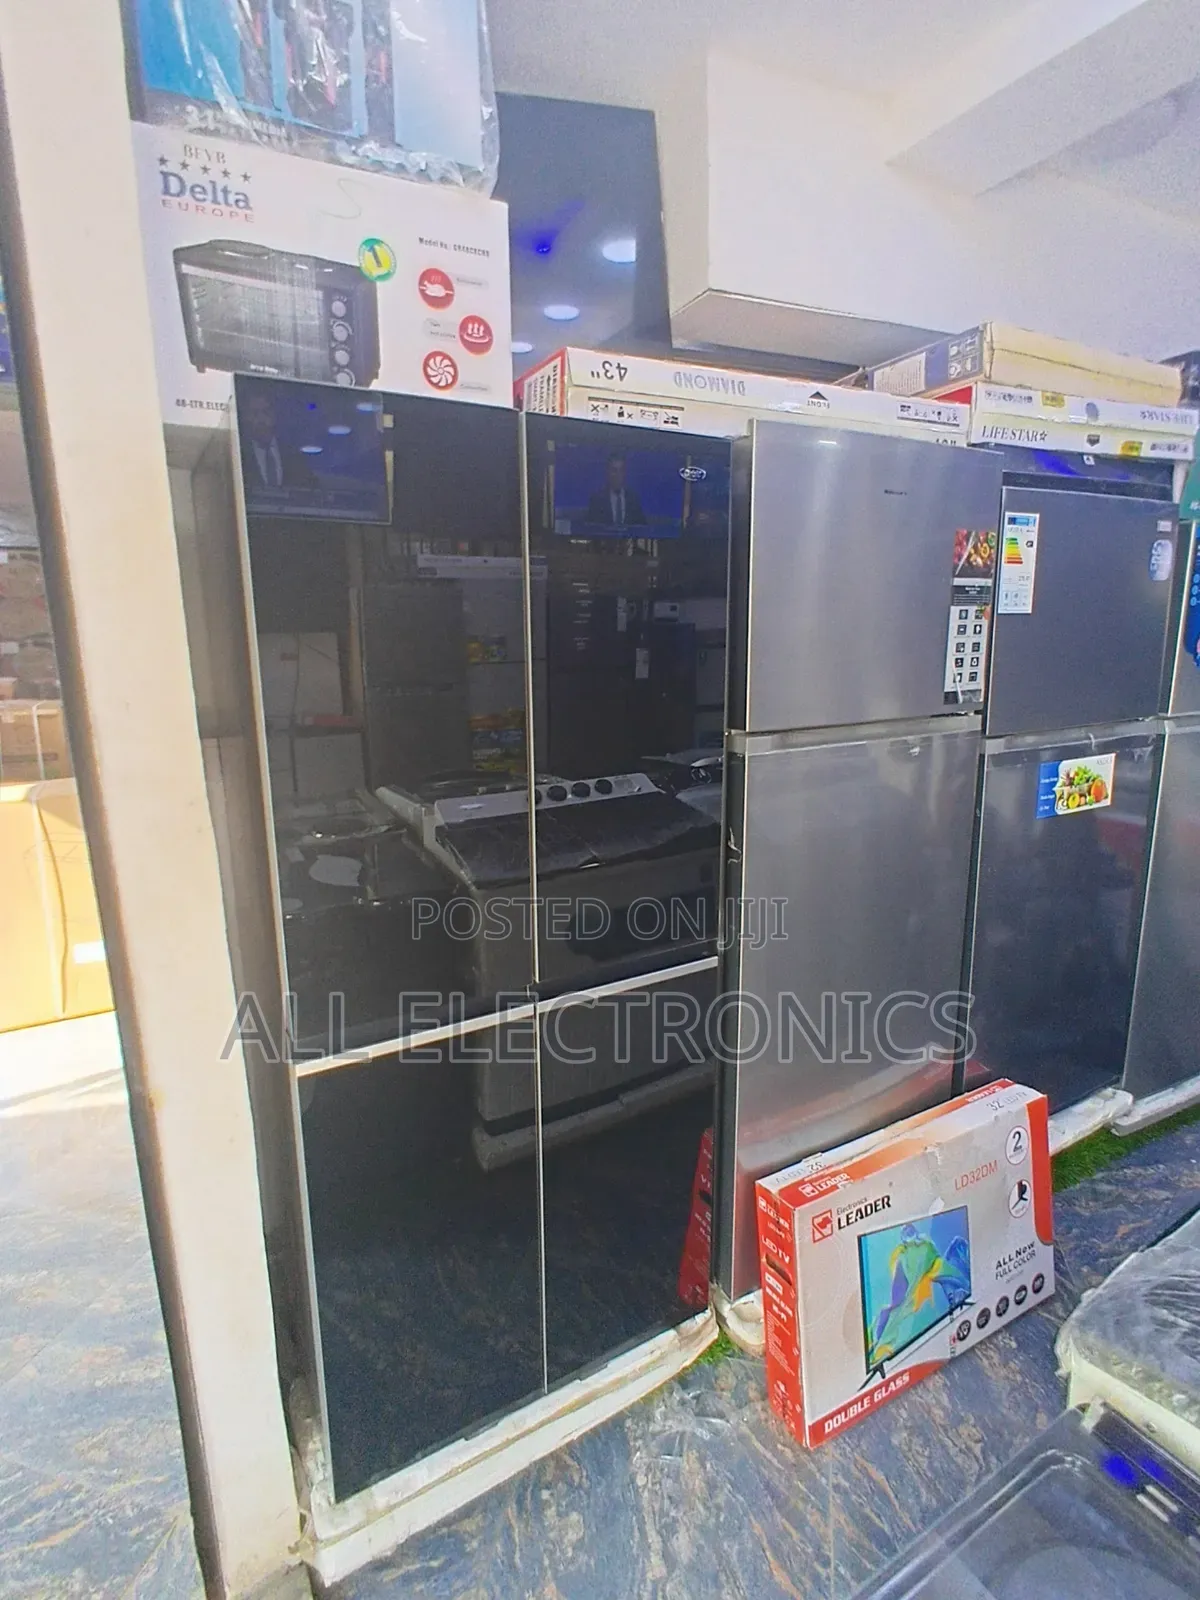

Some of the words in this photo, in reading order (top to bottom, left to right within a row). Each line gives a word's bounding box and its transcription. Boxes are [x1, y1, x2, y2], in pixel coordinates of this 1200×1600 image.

[160, 170, 253, 211] Delta
[162, 199, 254, 223] EUROPE
[590, 360, 628, 382] 43"
[674, 371, 746, 396] DIAMOND
[982, 425, 1009, 440] LIFE
[1013, 1131, 1023, 1152] 2
[954, 1160, 997, 1191] LD32DM
[837, 1195, 891, 1230] LEADER
[762, 1234, 778, 1254] LED
[778, 1247, 790, 1264] TV
[995, 1253, 1014, 1270] ALL
[1015, 1241, 1035, 1258] New
[995, 1264, 1012, 1280] FULL
[1013, 1249, 1036, 1269] COLOR
[824, 1395, 871, 1434] DOUBLE
[873, 1371, 911, 1403] GLASS
